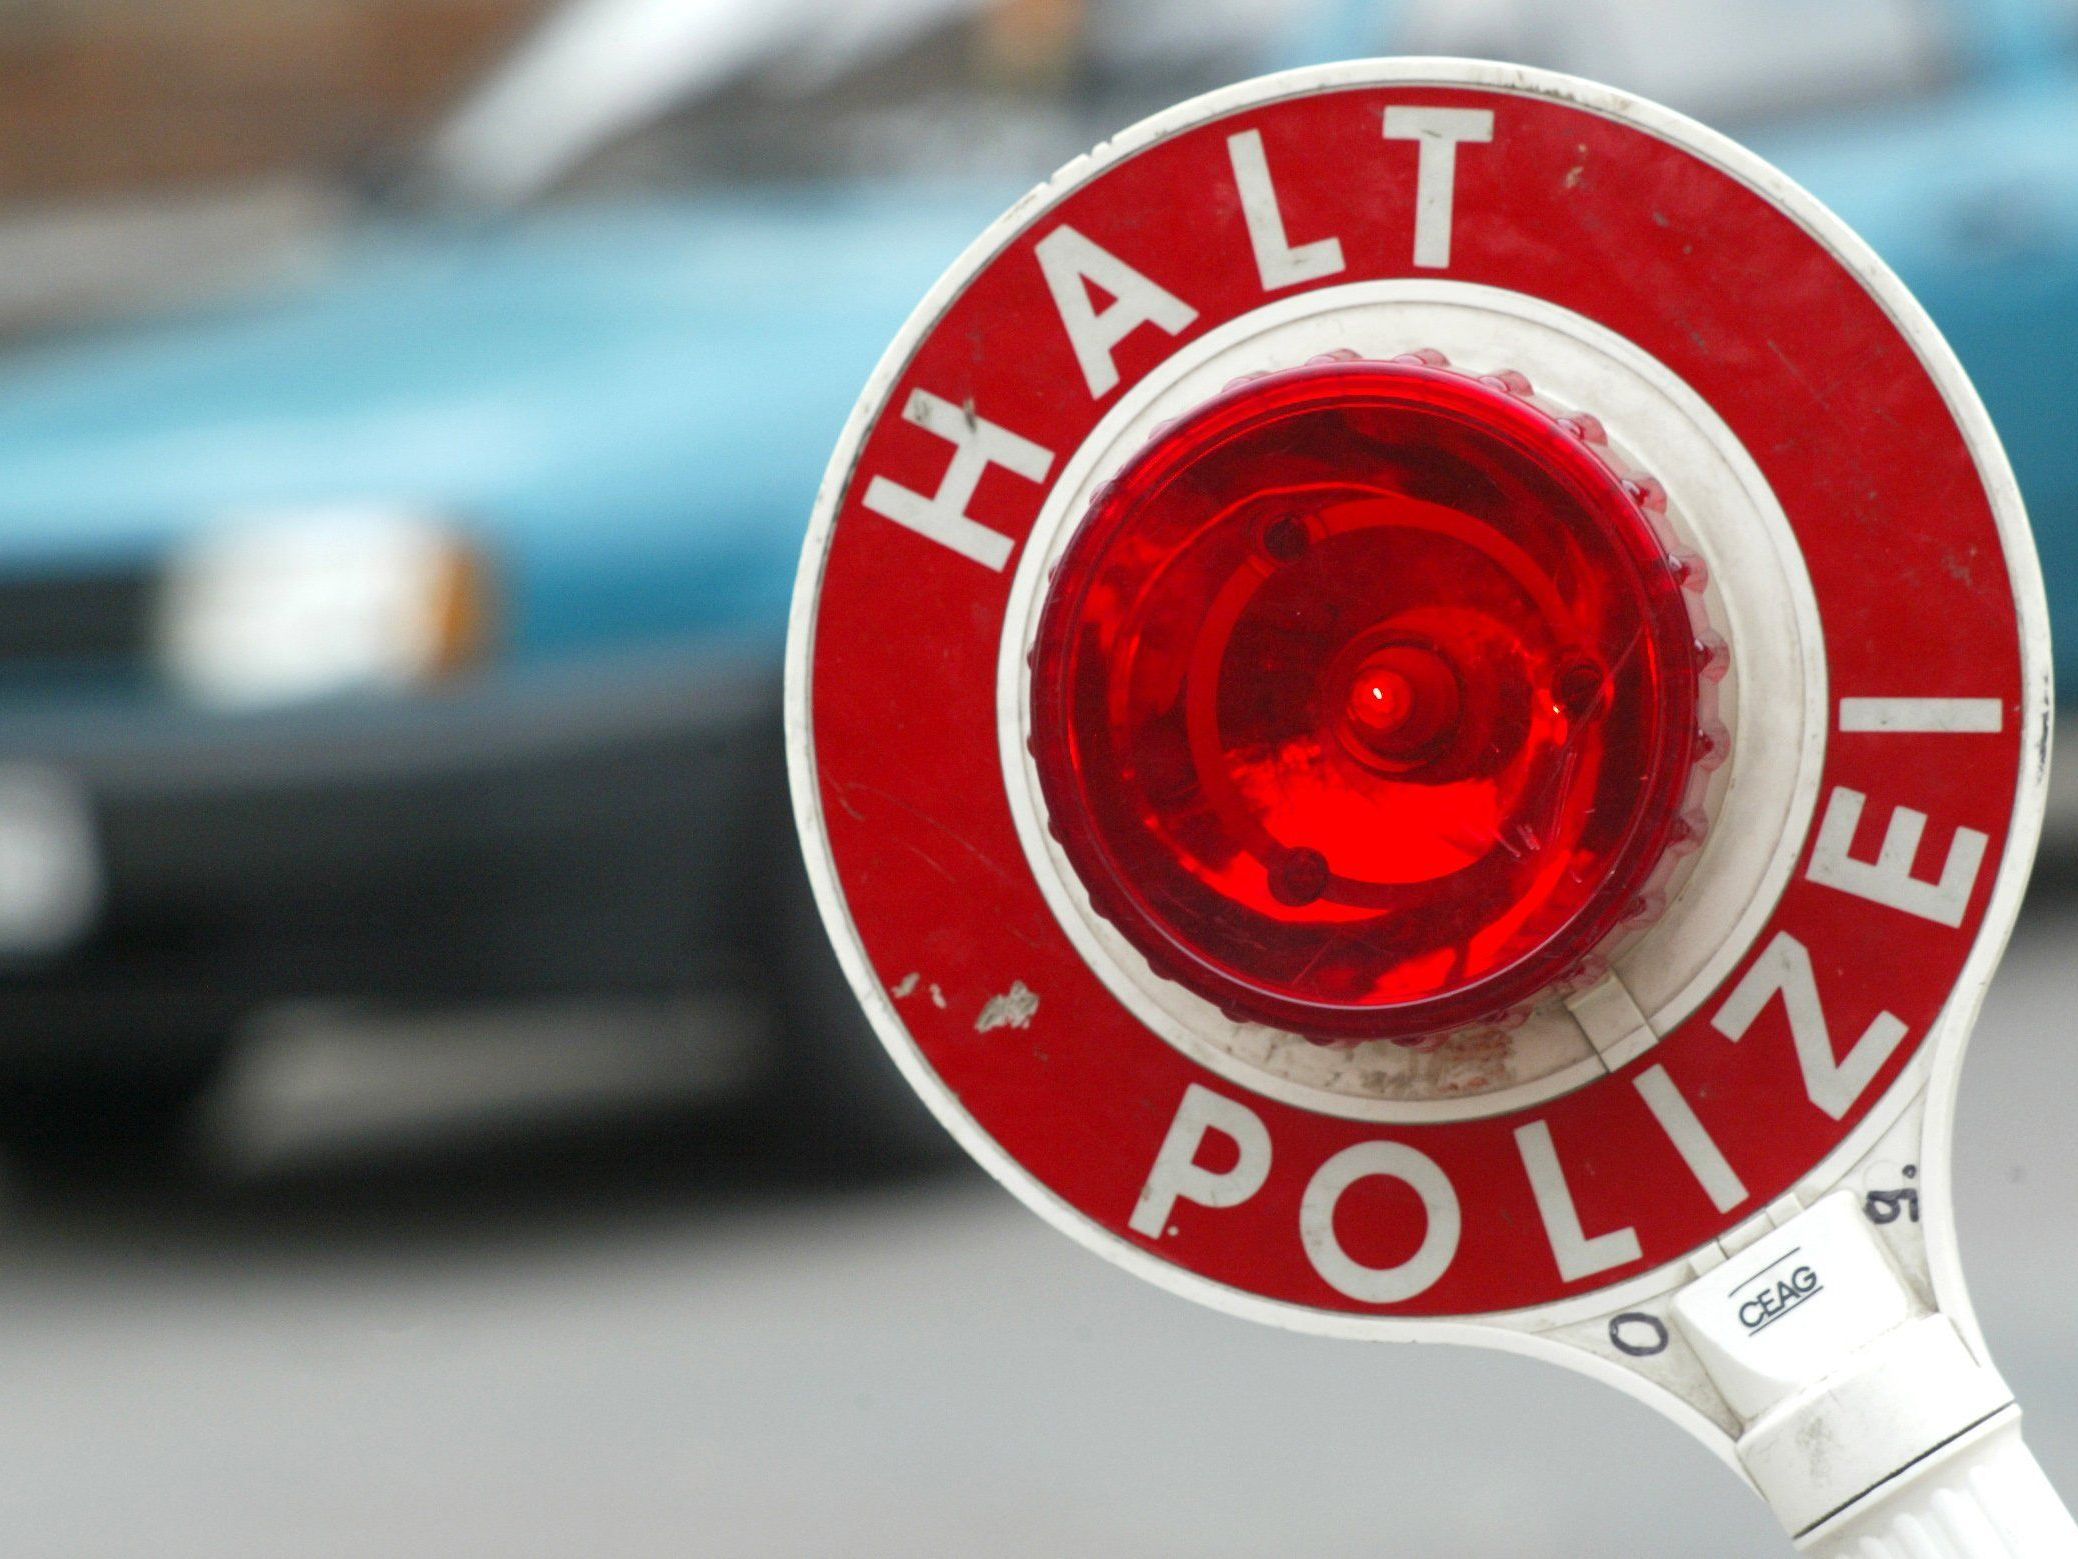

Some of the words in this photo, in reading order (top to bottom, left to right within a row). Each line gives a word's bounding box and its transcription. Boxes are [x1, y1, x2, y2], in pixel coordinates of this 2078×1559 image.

[863, 106, 1494, 571] HALT
[1129, 698, 2002, 1303] POLIZEI
[1738, 1266, 1818, 1328] CEAG
